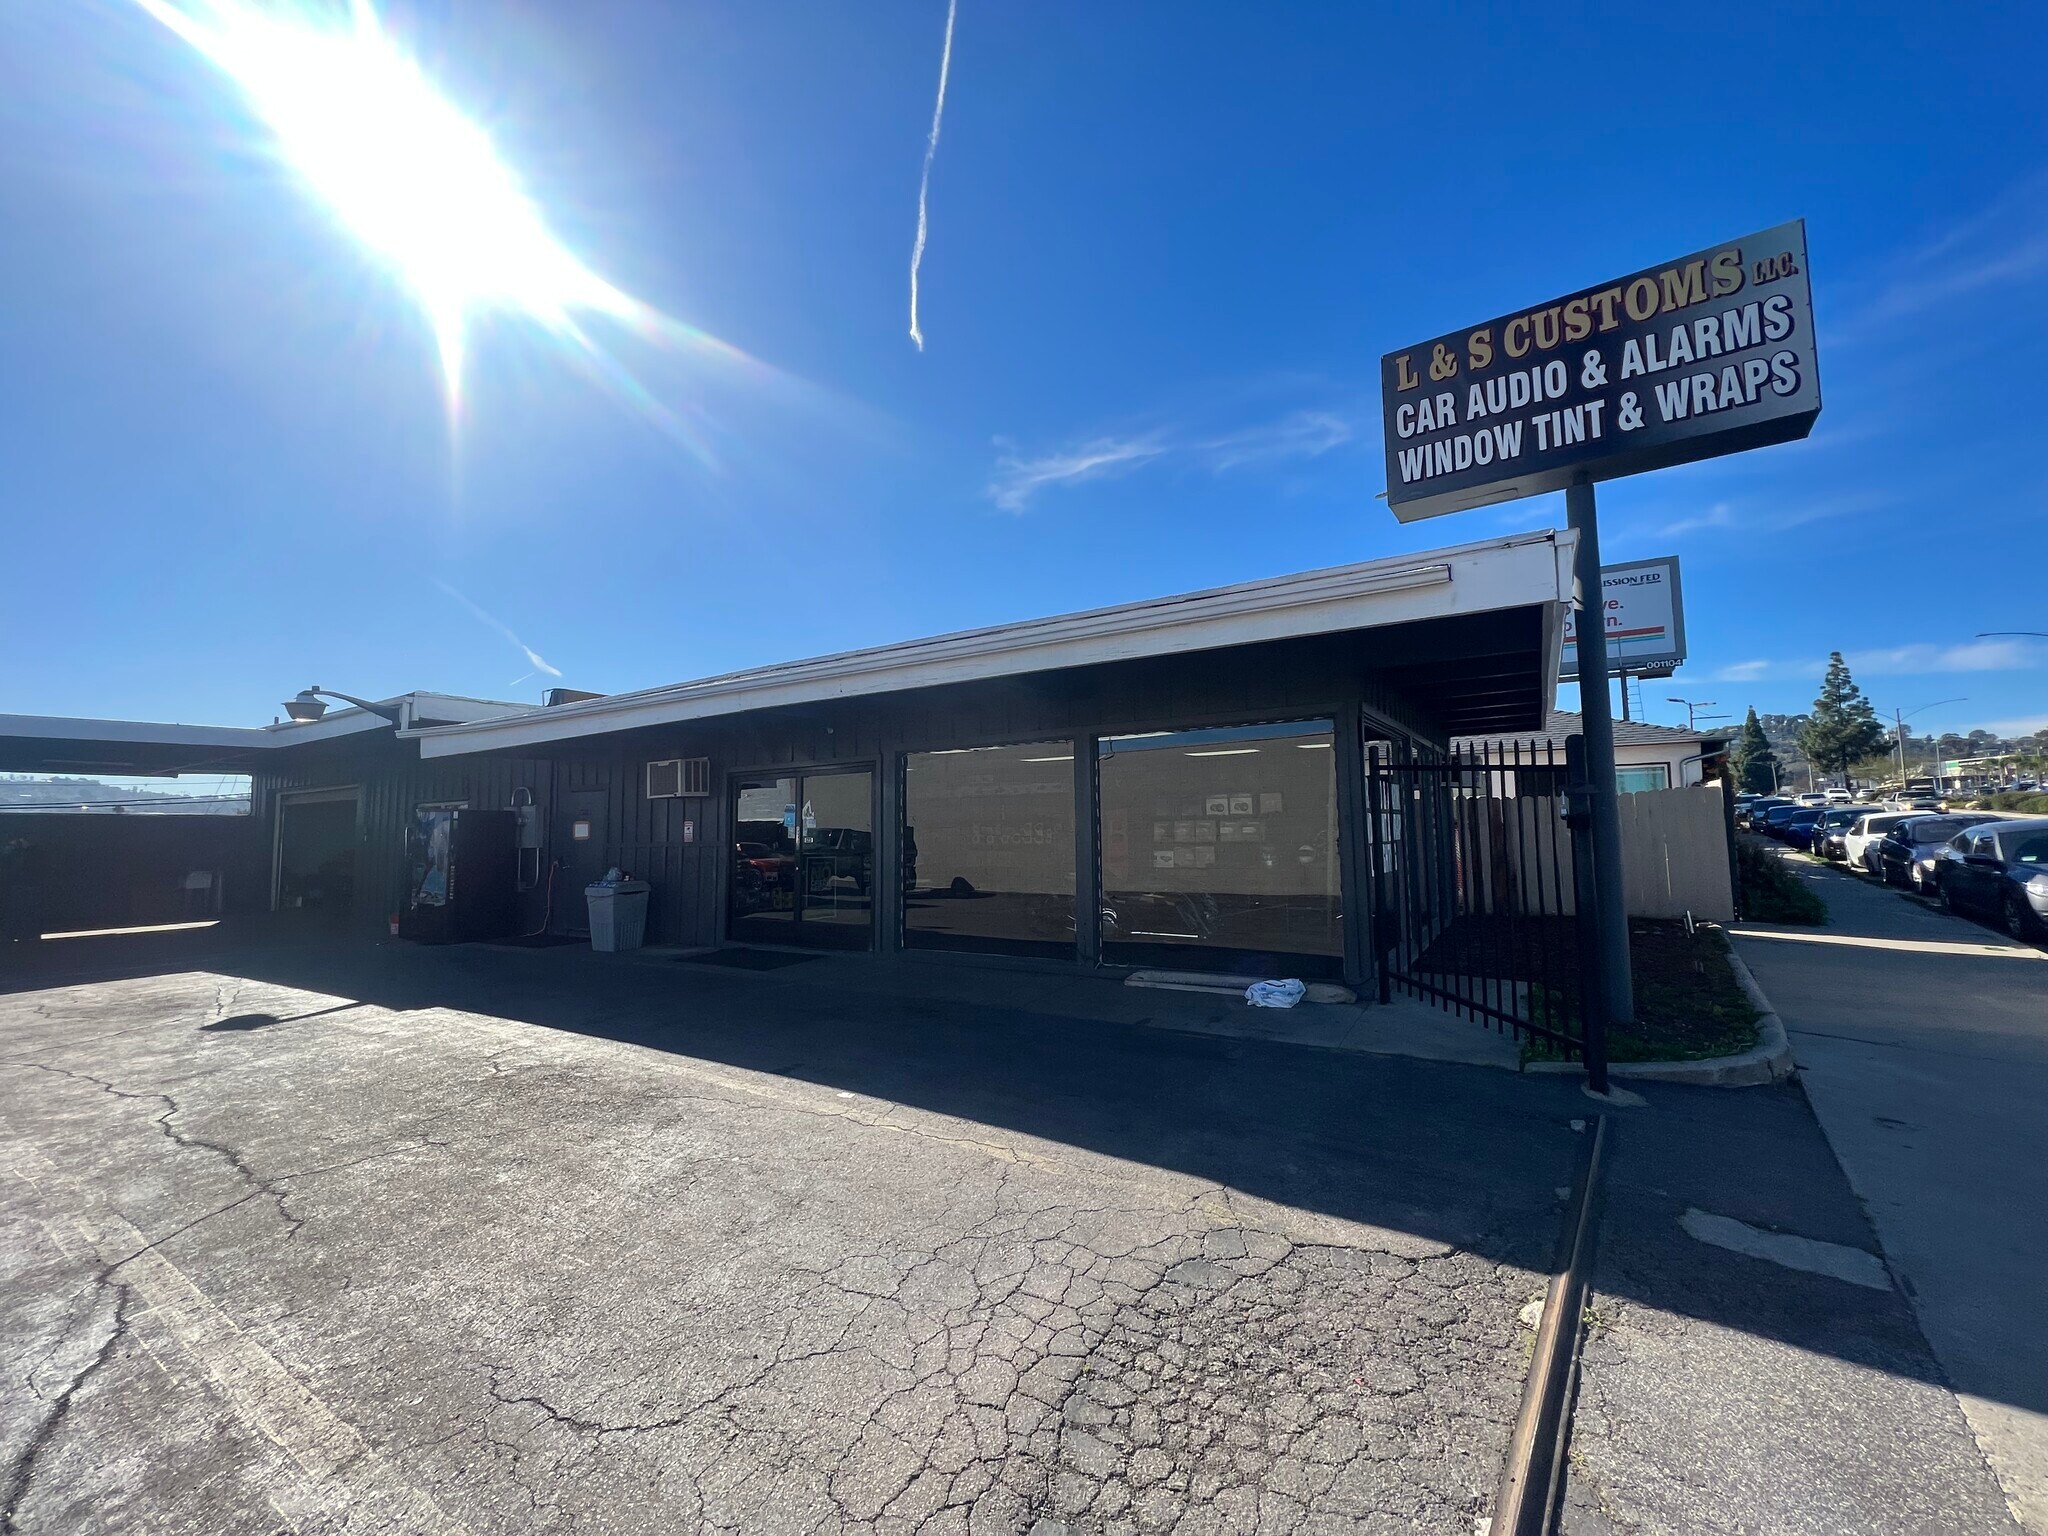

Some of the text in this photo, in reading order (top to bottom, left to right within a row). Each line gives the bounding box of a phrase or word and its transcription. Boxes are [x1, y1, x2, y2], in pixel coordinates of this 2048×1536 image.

[1396, 355, 1419, 391] L
[1429, 343, 1458, 381] &
[1468, 329, 1492, 370] S
[1504, 249, 1744, 358] CUSTOMS
[1396, 295, 1794, 438] CAR AUDIO & ALARMS
[1398, 350, 1799, 483] WINDOW TINT & WRAPS
[1602, 576, 1638, 586] ISSION
[1640, 573, 1660, 582] FED
